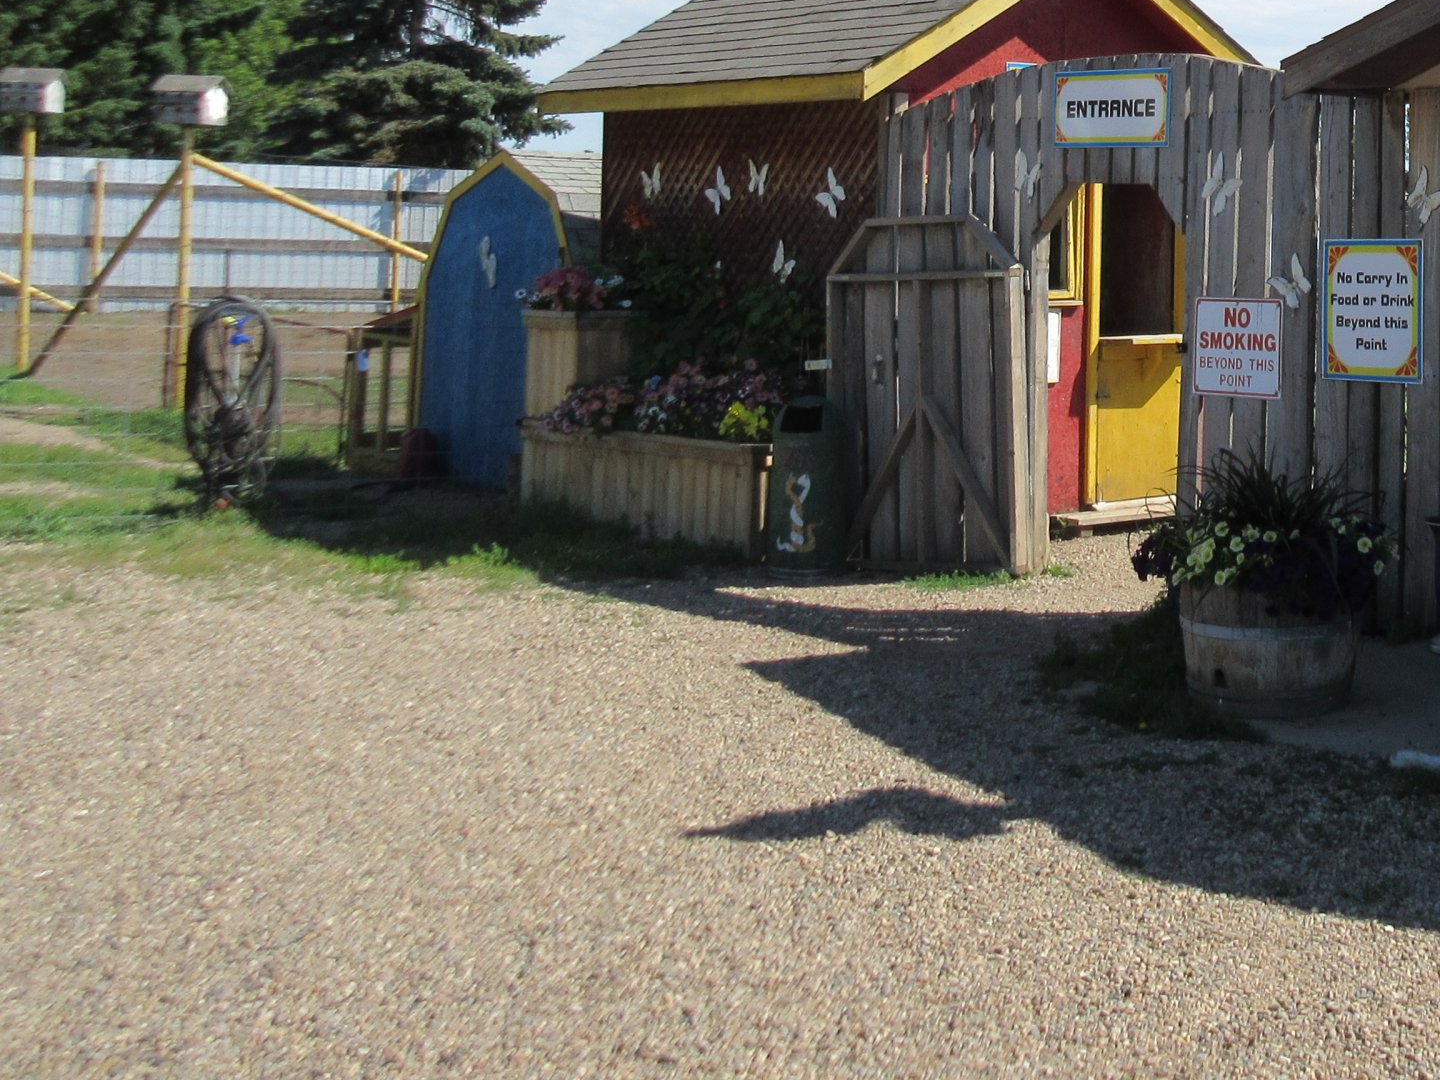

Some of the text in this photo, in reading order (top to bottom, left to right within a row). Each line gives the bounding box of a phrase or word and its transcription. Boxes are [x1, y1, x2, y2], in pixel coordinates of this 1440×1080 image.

[1067, 98, 1156, 118] ENTRANCE
[1337, 272, 1408, 287] No Carry In
[1331, 294, 1414, 307] Food or Drink
[1224, 307, 1251, 328] NO
[1336, 315, 1408, 331] Beyond this
[1200, 331, 1276, 352] SMOKING
[1356, 338, 1387, 350] Point
[1200, 356, 1275, 372] BEYOND THIS
[1220, 374, 1252, 388] POINT
